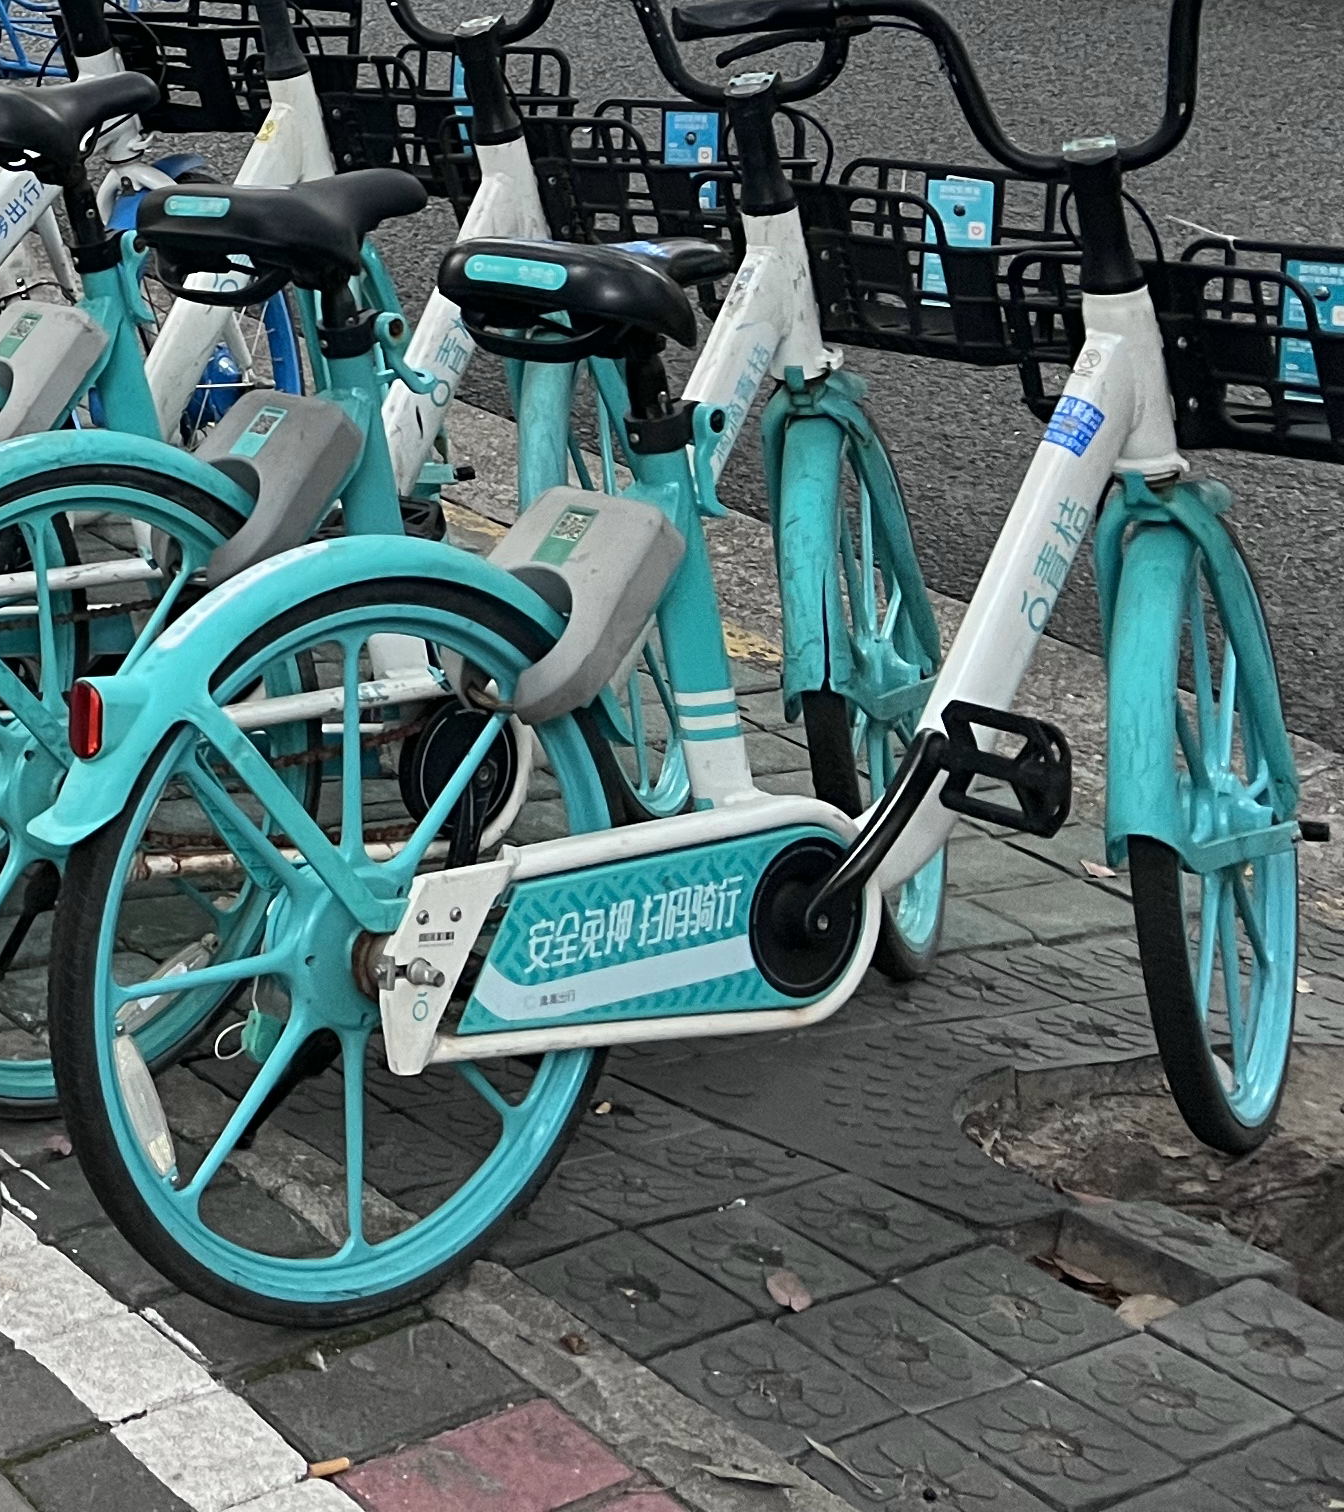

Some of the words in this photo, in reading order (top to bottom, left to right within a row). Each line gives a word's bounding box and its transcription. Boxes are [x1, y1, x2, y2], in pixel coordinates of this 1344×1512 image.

[1033, 496, 1090, 593] 青桔
[524, 899, 635, 974] 安全免押
[637, 875, 744, 947] 扫码骑行
